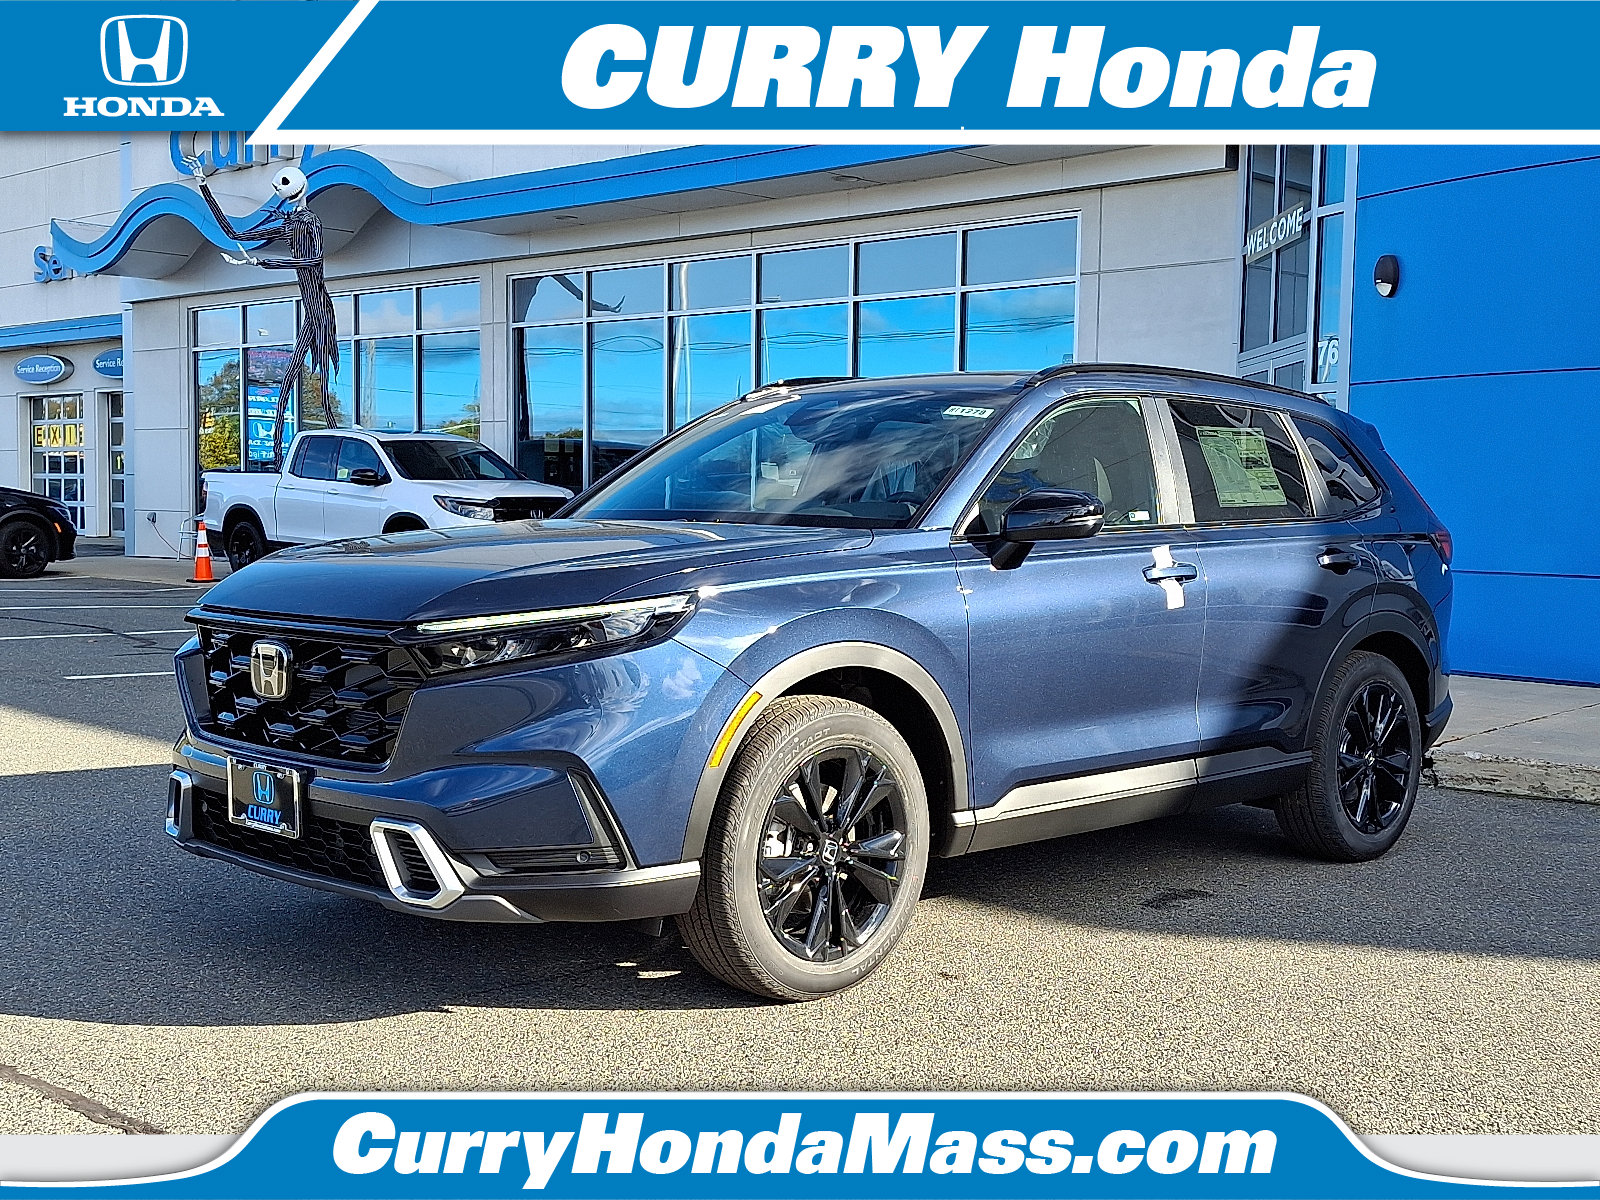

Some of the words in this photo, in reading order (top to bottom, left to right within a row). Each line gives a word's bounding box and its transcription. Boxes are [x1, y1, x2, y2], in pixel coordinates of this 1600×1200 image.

[1246, 206, 1304, 256] WELCOME
[1317, 339, 1339, 366] 76
[17, 365, 35, 374] Service
[36, 363, 61, 374] Reception
[96, 358, 116, 368] Service
[36, 426, 84, 446] EXI
[247, 804, 282, 825] CURRY
